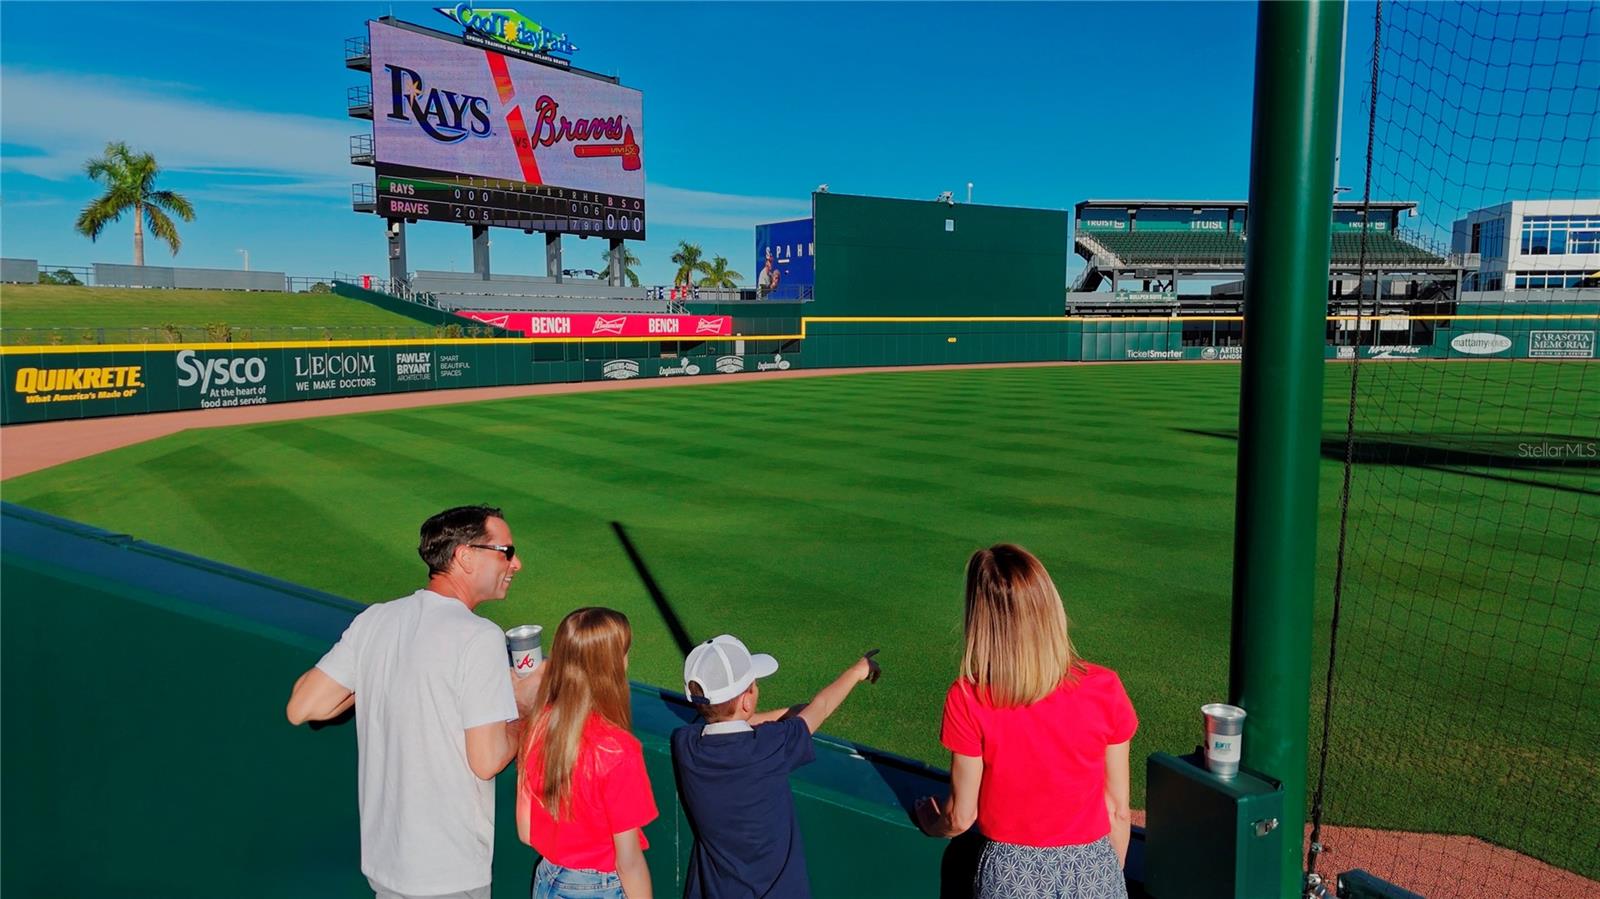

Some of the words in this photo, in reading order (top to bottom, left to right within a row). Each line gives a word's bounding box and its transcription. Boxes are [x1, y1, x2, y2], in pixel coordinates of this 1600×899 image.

[384, 64, 492, 143] RAYS
[532, 95, 623, 150] Braves
[390, 182, 415, 195] RAYS
[390, 200, 429, 214] BRAVES
[766, 243, 814, 259] SPAHN
[531, 317, 571, 333] BENCH
[648, 318, 679, 333] BENCH
[1535, 333, 1589, 341] SARASOTA
[1534, 341, 1589, 349] MEMORIAL
[396, 352, 431, 364] FAWLEY
[1127, 349, 1183, 358] TicketSmarter
[396, 363, 431, 375] BRYANT
[440, 369, 462, 377] SPACES
[15, 366, 141, 393] QUIKRETE
[397, 373, 431, 381] ARCHITECTURE
[296, 381, 310, 391] WE
[313, 380, 336, 389] MAKE
[340, 378, 376, 388] DOCTORS
[26, 395, 51, 403] What
[53, 392, 96, 402] America's
[98, 390, 121, 399] Made
[210, 388, 220, 398] At
[221, 387, 235, 396] the
[235, 386, 257, 396] heart
[257, 385, 267, 394] of
[201, 398, 221, 408] food
[222, 397, 238, 407] and
[240, 396, 267, 405] service
